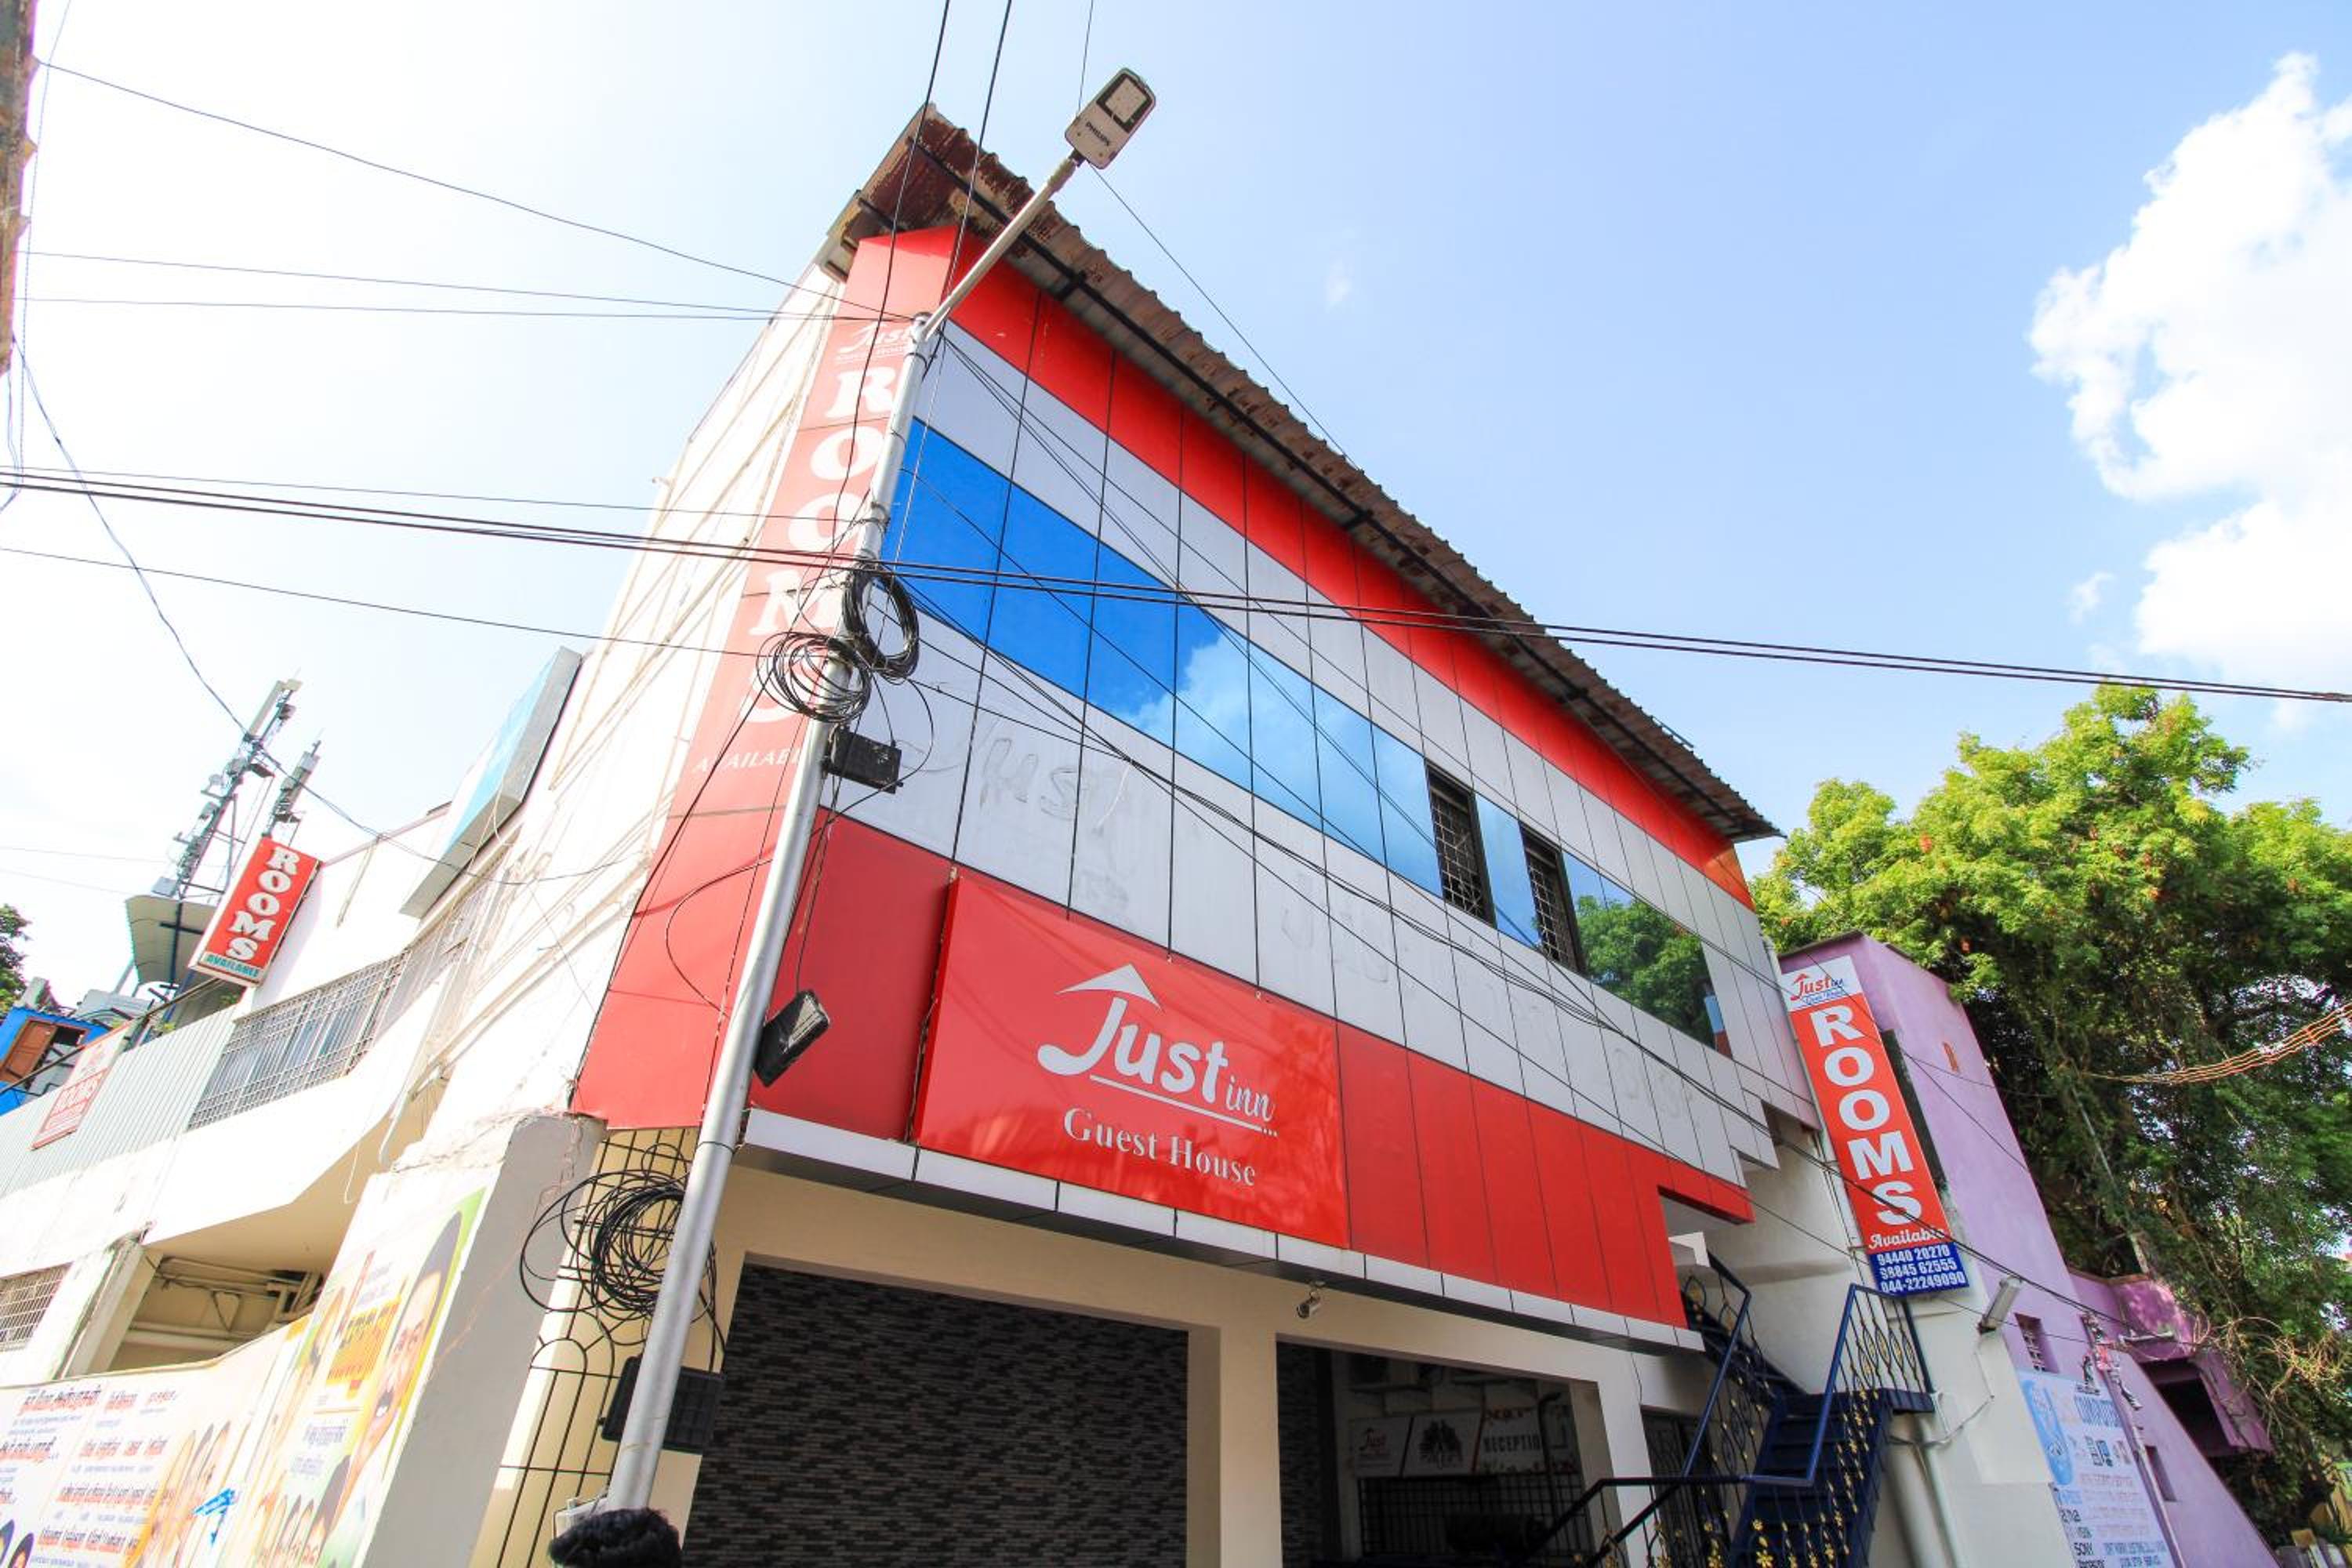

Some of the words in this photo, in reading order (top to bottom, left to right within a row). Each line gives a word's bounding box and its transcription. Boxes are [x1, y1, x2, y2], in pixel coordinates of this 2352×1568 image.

[225, 846, 301, 961] ROOMS
[1790, 975, 1831, 1001] Just
[1036, 996, 1229, 1104] Just
[1225, 1076, 1276, 1123] inn
[1063, 1107, 1158, 1160] Guest
[1168, 1135, 1257, 1187] House
[1809, 1004, 1922, 1226] ROOMS
[1876, 1249, 1914, 1266] 94440
[1913, 1244, 1951, 1261] 20270
[1918, 1257, 1958, 1275] 62555
